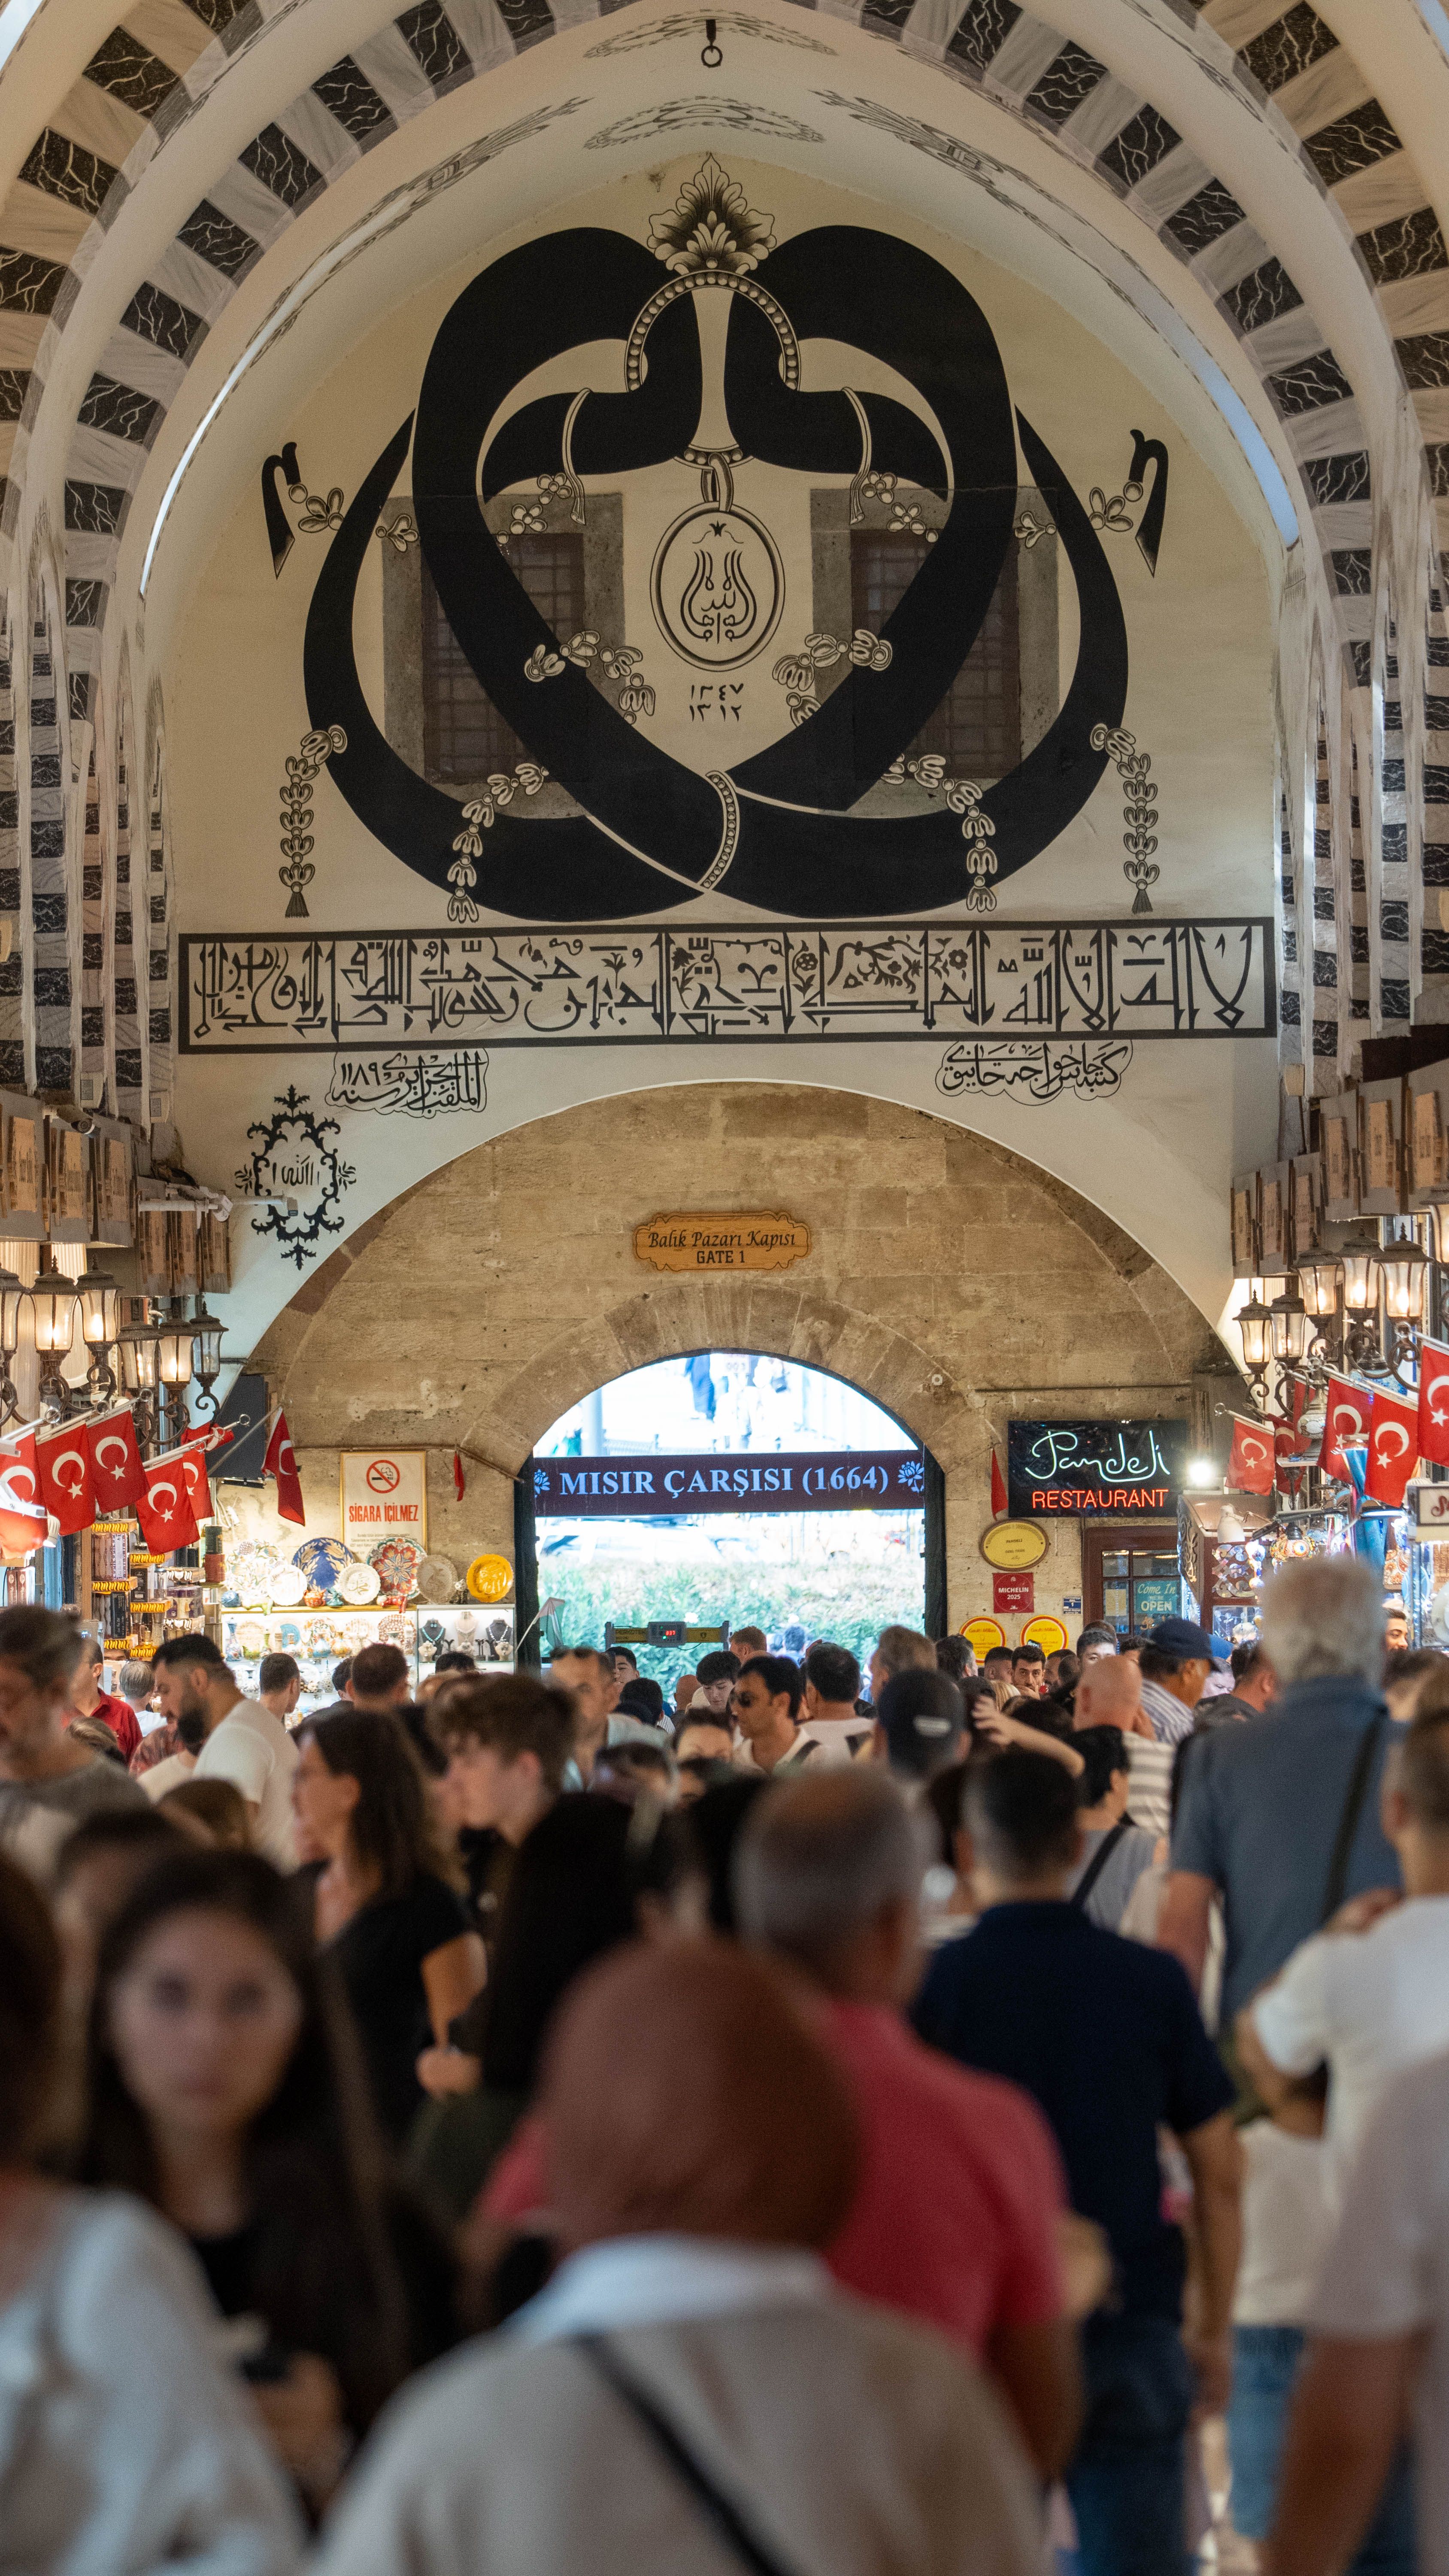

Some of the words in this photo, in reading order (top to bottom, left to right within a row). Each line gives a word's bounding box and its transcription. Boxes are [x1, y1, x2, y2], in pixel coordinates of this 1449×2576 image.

[691, 1231, 741, 1247] Pazarı
[746, 1230, 795, 1252] Kapısı
[697, 1251, 734, 1264] GATE
[740, 1251, 745, 1263] 1
[1025, 1431, 1170, 1482] Pandeli
[560, 1470, 656, 1496] MISIR
[664, 1468, 794, 1498] ÇARŞISI
[803, 1466, 888, 1496] (1664)
[1033, 1489, 1169, 1509] RESTAURANT
[349, 1503, 382, 1522] SİGARA
[384, 1502, 419, 1524] İÇİLMEZ
[1138, 1584, 1160, 1594] Come
[1164, 1584, 1176, 1594] In
[1141, 1601, 1172, 1611] OPEN
